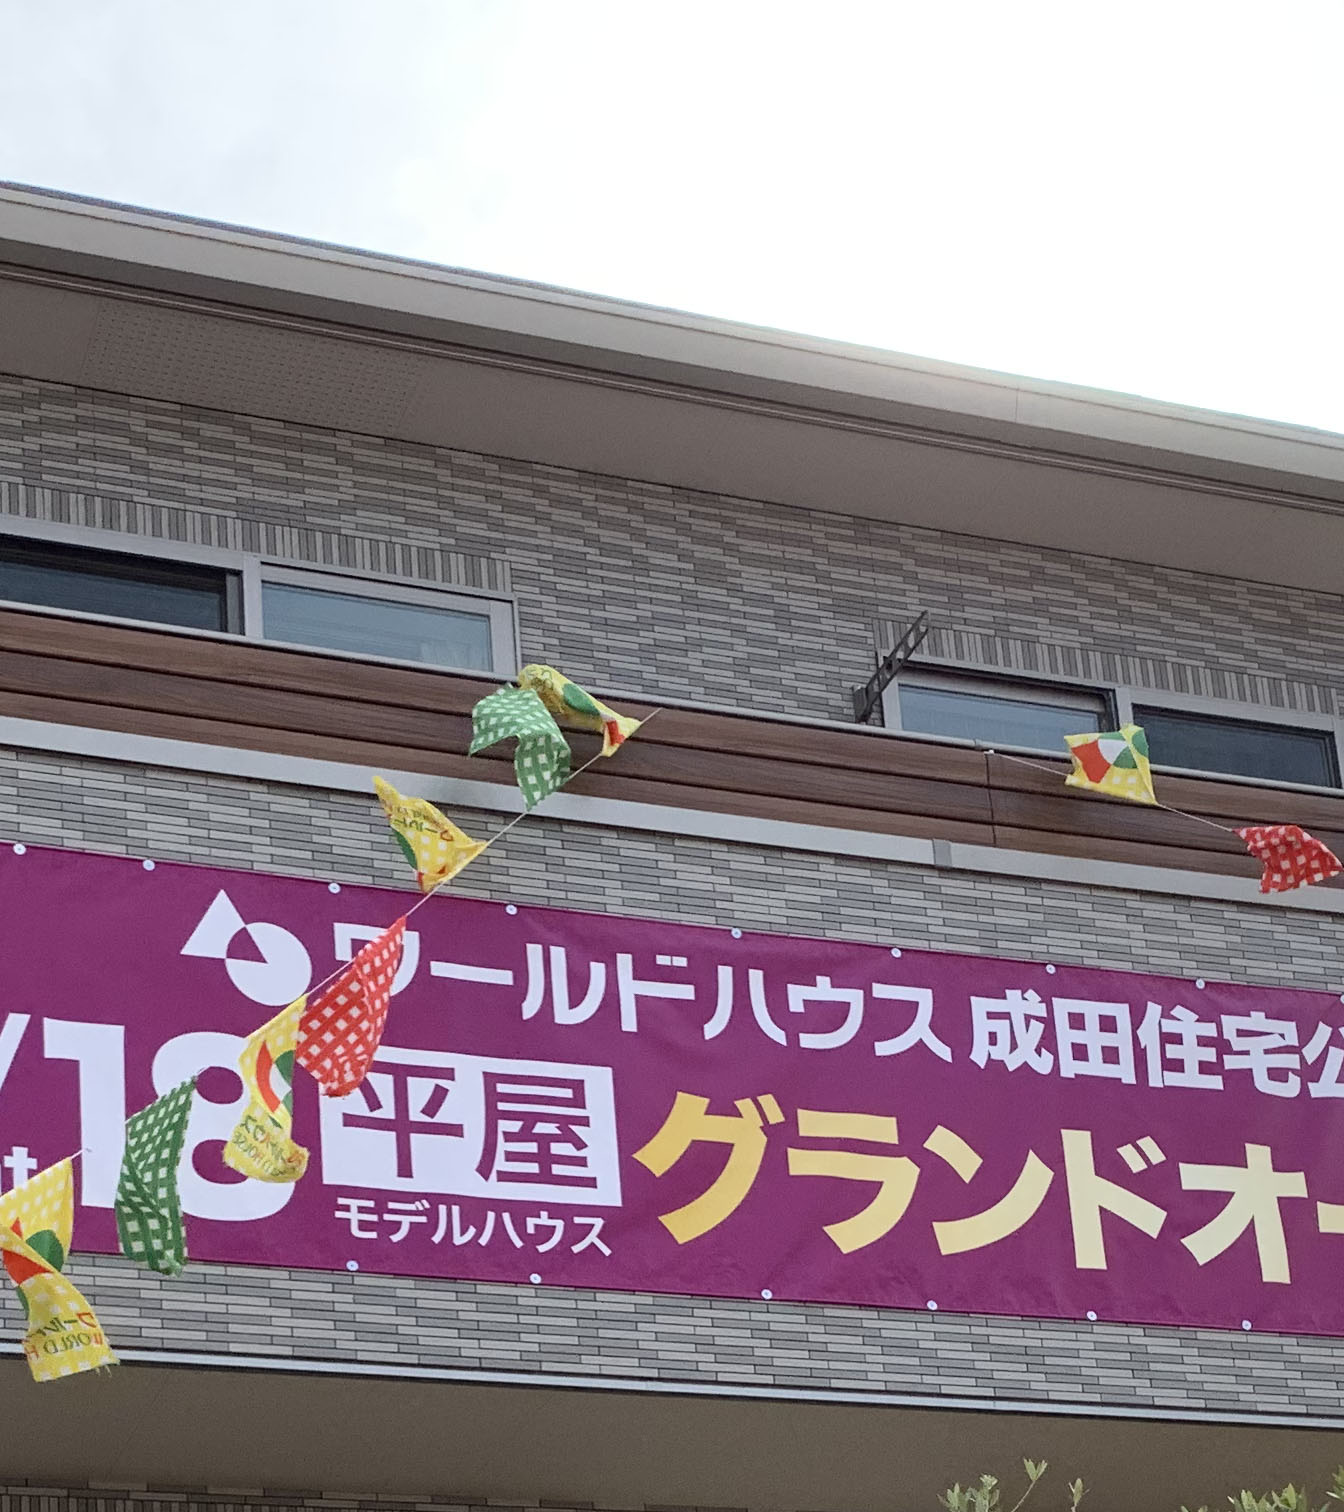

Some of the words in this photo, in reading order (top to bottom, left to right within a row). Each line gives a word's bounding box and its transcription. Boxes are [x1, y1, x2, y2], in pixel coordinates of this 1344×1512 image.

[333, 921, 954, 1066] ワールドハウス
[342, 1058, 598, 1190] 平屋
[334, 1197, 613, 1257] モデルハウス
